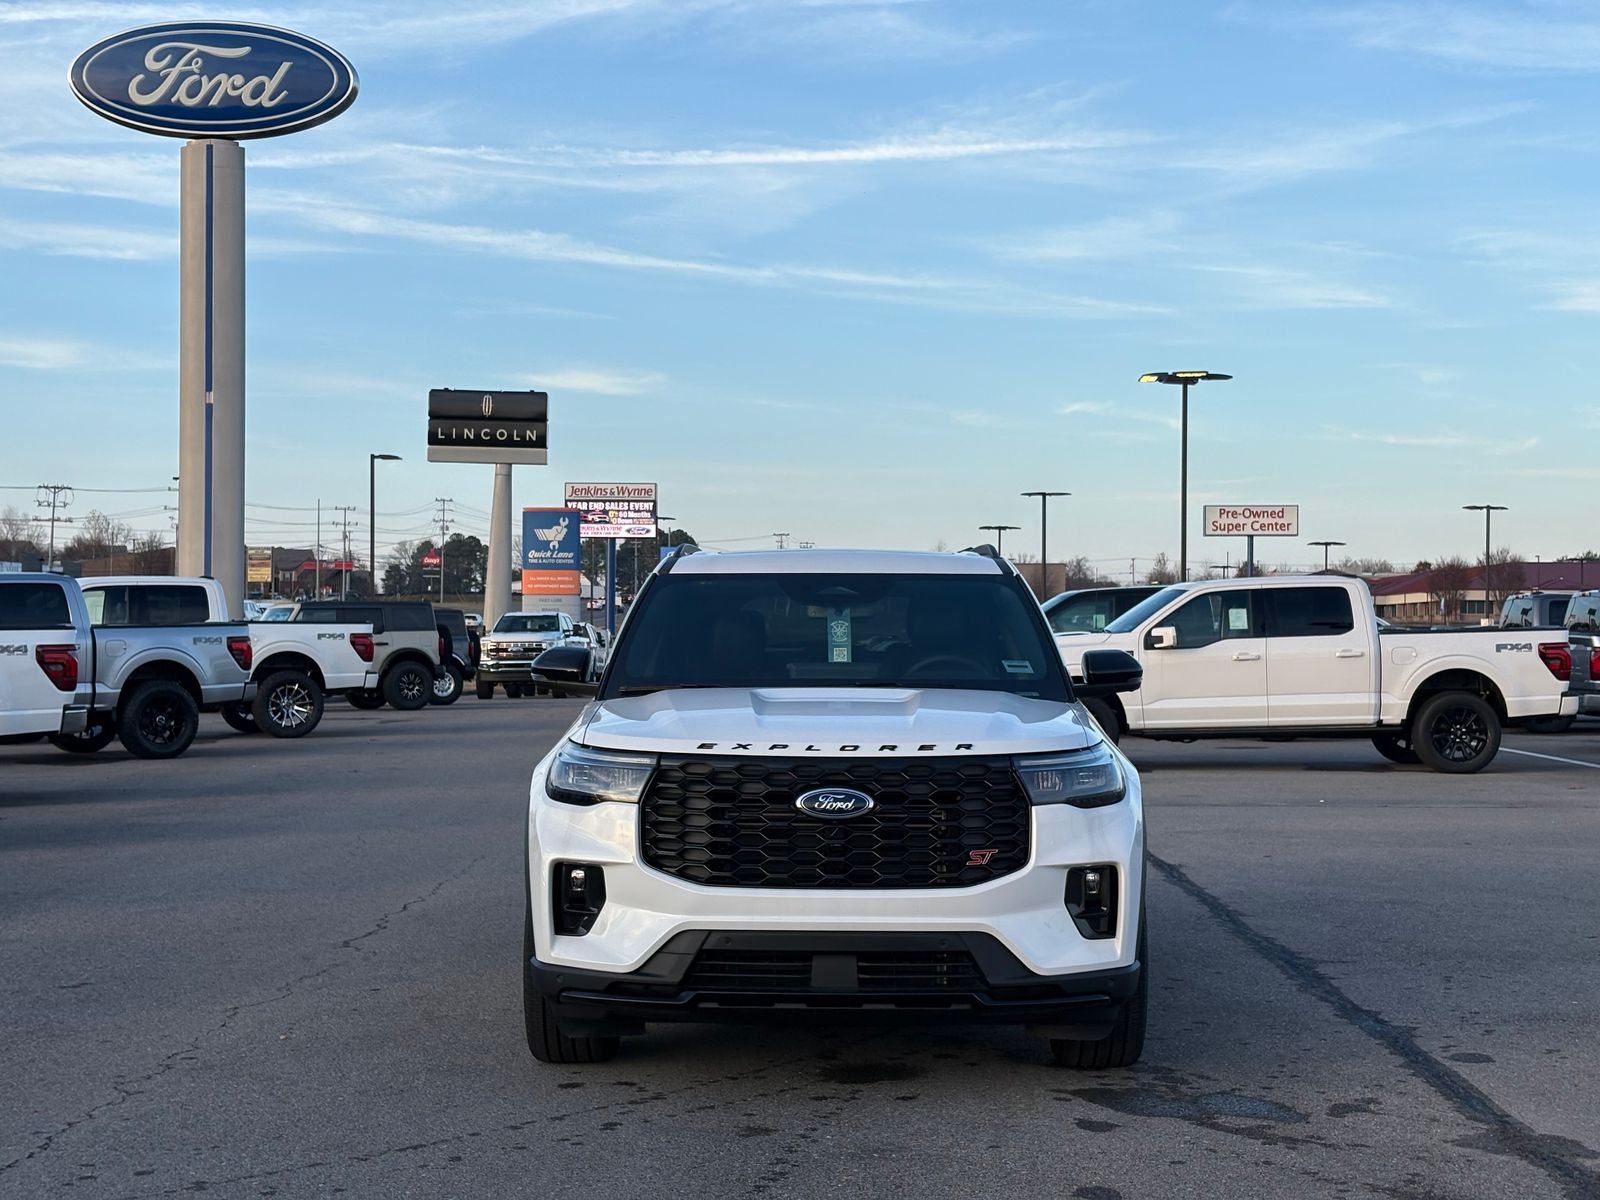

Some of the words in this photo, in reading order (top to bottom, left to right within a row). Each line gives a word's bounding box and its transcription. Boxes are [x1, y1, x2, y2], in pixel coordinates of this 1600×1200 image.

[128, 42, 293, 107] Ford
[438, 428, 537, 441] LINCOLN
[568, 486, 608, 497] Jenkins
[609, 487, 615, 496] &
[616, 486, 653, 497] Wynne
[567, 502, 588, 510] YEAR
[589, 502, 604, 510] END
[605, 502, 628, 510] SALES
[629, 502, 654, 510] EVENT
[1219, 508, 1284, 519] Pre-Owned
[1211, 520, 1247, 533] Super
[1250, 520, 1292, 531] Center
[528, 550, 551, 558] Quick
[552, 550, 574, 558] Lane
[193, 637, 223, 645] FX4
[0, 644, 28, 653] X4
[1495, 643, 1533, 653] FX4
[697, 743, 974, 751] EXPLORER
[814, 793, 855, 811] Ford
[966, 849, 998, 866] ST
